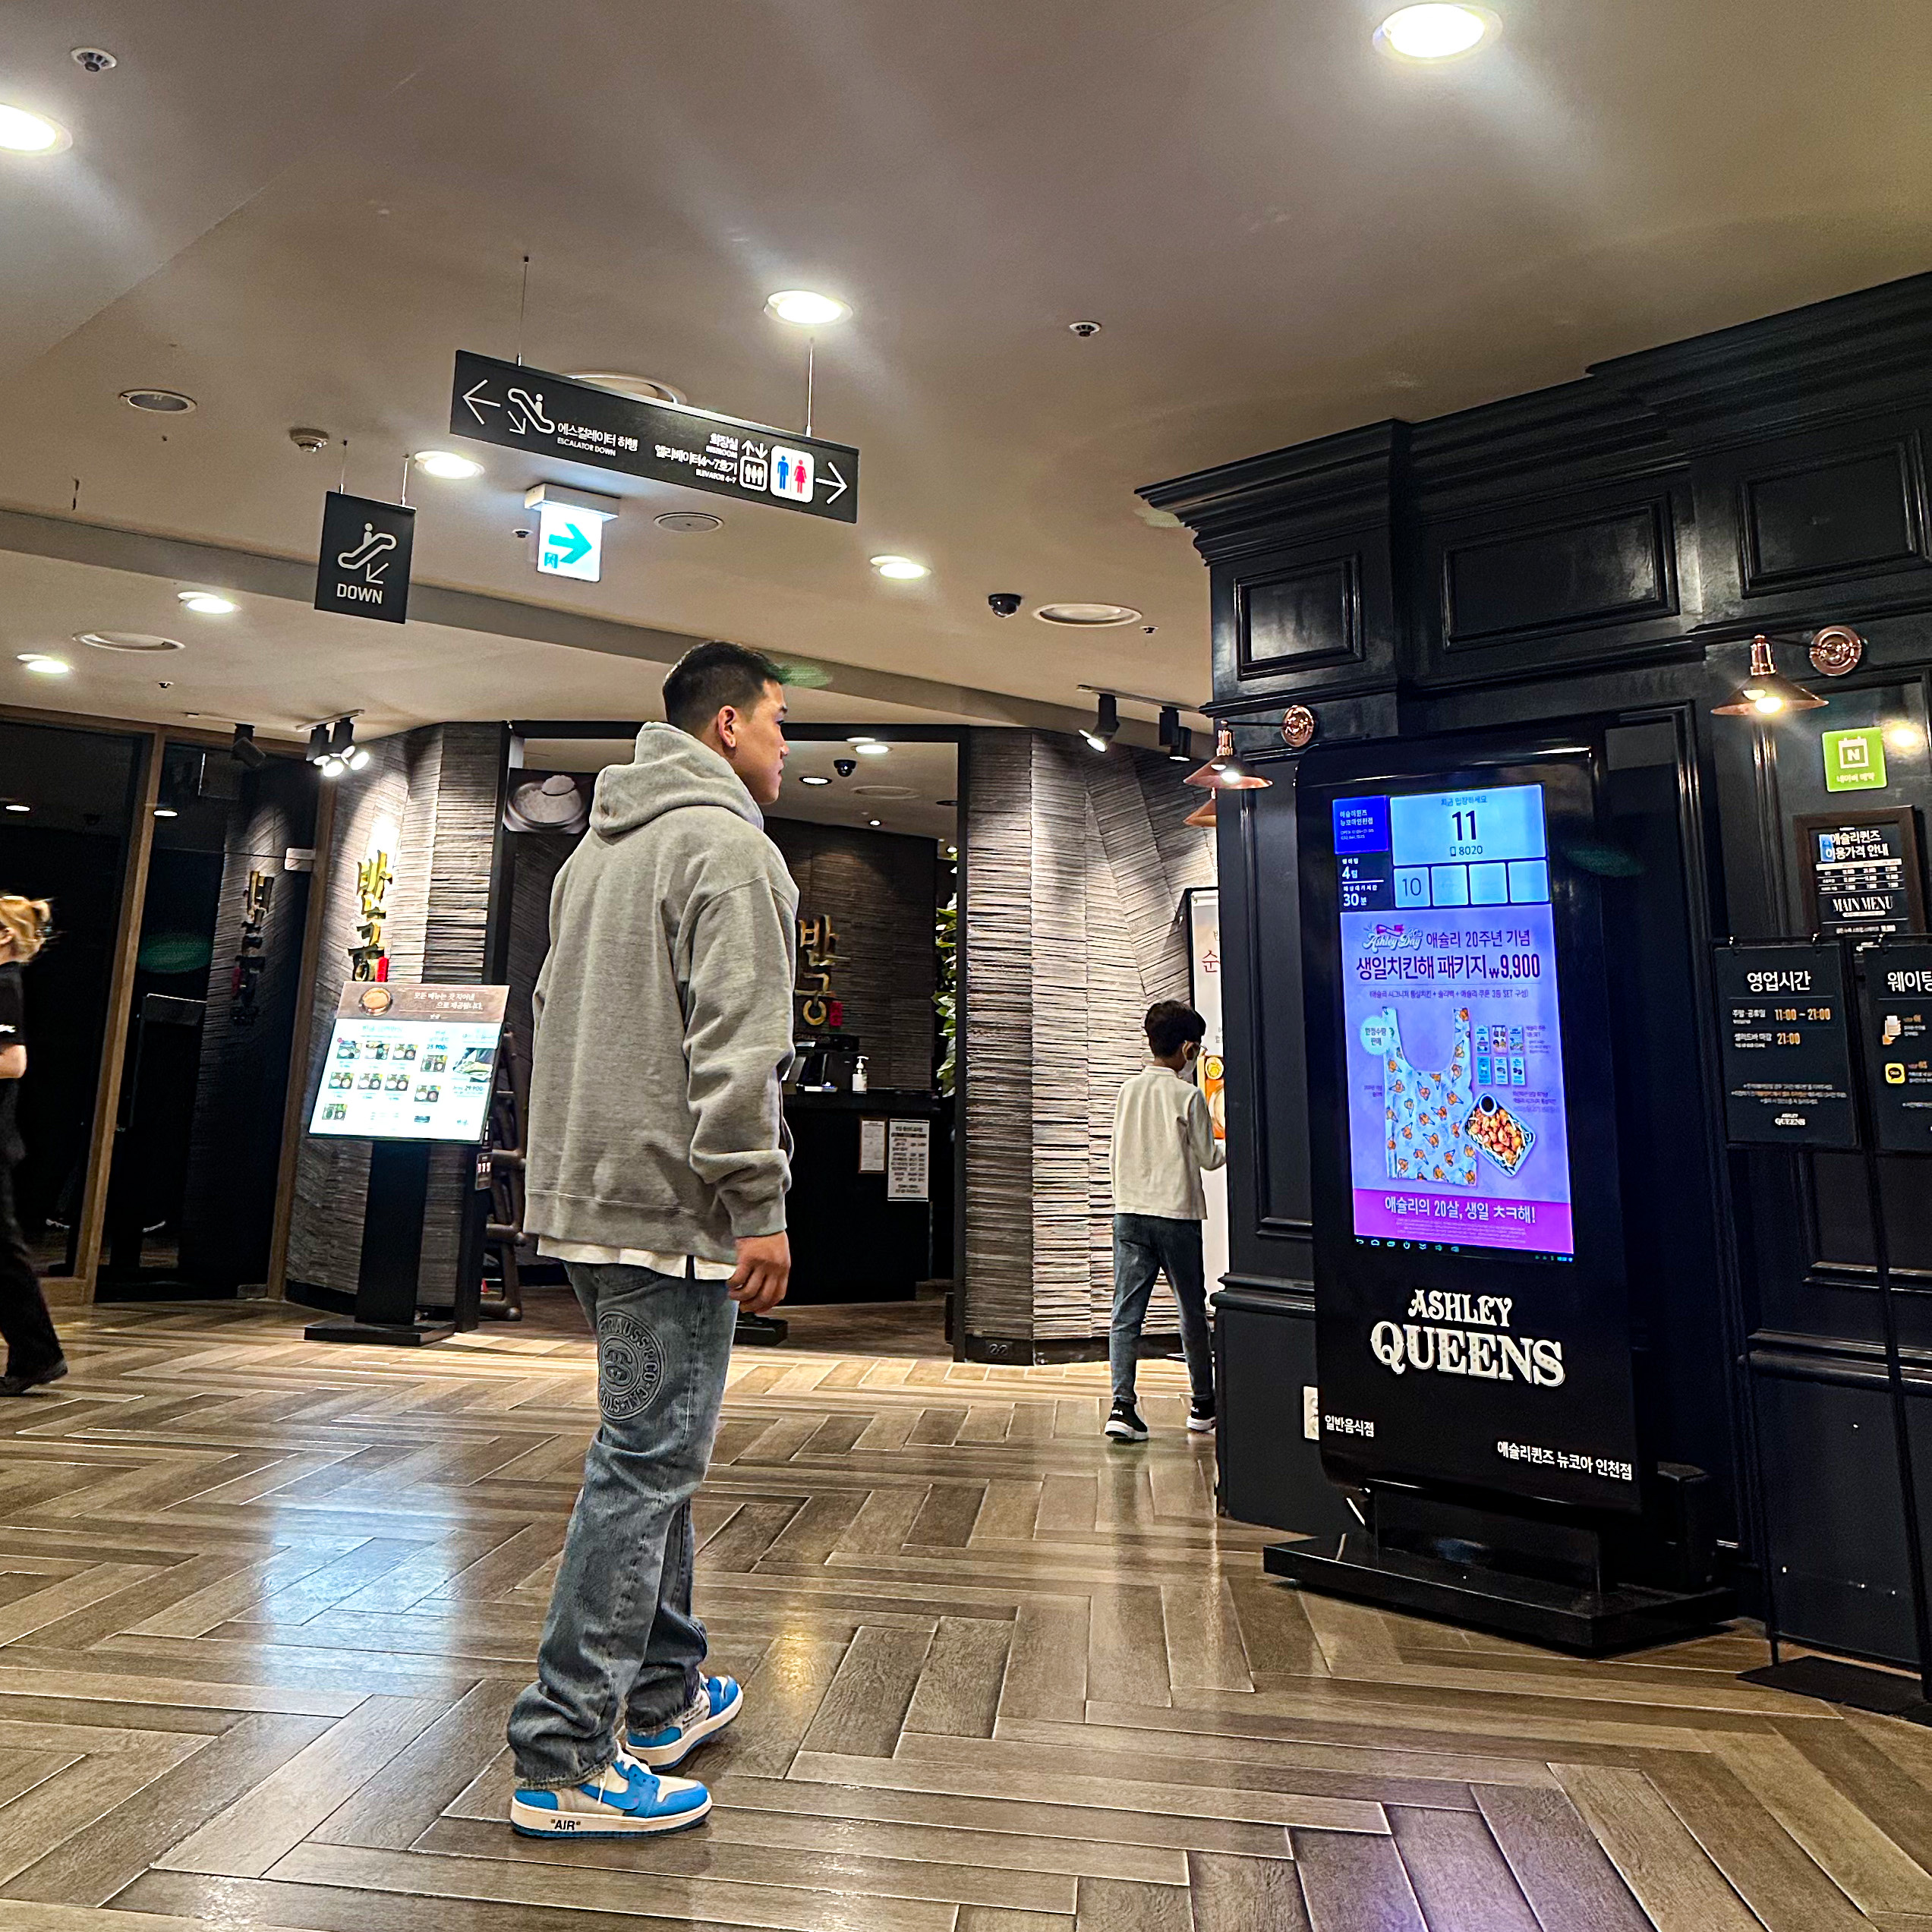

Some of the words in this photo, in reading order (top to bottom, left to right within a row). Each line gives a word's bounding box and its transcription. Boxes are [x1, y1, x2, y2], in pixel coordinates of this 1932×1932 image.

[557, 423, 616, 446] 에스컬레이터
[618, 437, 638, 452] 하행
[557, 437, 594, 452] ESCALATOR
[594, 446, 616, 456] DOWN
[709, 433, 739, 451] 화장실
[337, 583, 383, 604] DOWN
[1847, 749, 1861, 761] N
[1836, 774, 1859, 783] 네이버
[1451, 810, 1477, 841] 11
[1458, 845, 1483, 856] 8020
[1825, 845, 1867, 860] 이용가격
[1867, 843, 1889, 858] 안내
[1401, 878, 1422, 897] 10
[1833, 897, 1861, 912] MAIN
[1861, 895, 1894, 910] MENU
[1362, 933, 1398, 953] Ashley
[1398, 934, 1422, 950] Day
[1426, 931, 1461, 949] 애슐리
[1465, 930, 1502, 948] 20주년
[1506, 929, 1530, 947] 기념
[1356, 955, 1435, 981] 생일치킨해
[1437, 954, 1486, 979] 패키지
[1747, 970, 1811, 992] 영업시간
[1887, 970, 1932, 992] 웨이팅
[1774, 1008, 1797, 1020] 11:00
[1808, 1008, 1831, 1020] 21:00
[1776, 1032, 1801, 1045] 21:00
[1385, 1196, 1430, 1216] 애슐리의
[1434, 1199, 1463, 1220] 20살,
[1464, 1202, 1489, 1221] 생일
[1492, 1205, 1536, 1224] ㅊㅋ해!
[1407, 1288, 1513, 1327] ASHLEY
[1370, 1320, 1566, 1388] QUEENS
[1325, 1414, 1375, 1438] 일반음식점
[1496, 1439, 1555, 1466] 애슐리퀸즈
[1556, 1451, 1593, 1474] 뉴코아
[1595, 1458, 1633, 1481] 인천점
[550, 1819, 581, 1830] "AIR"
